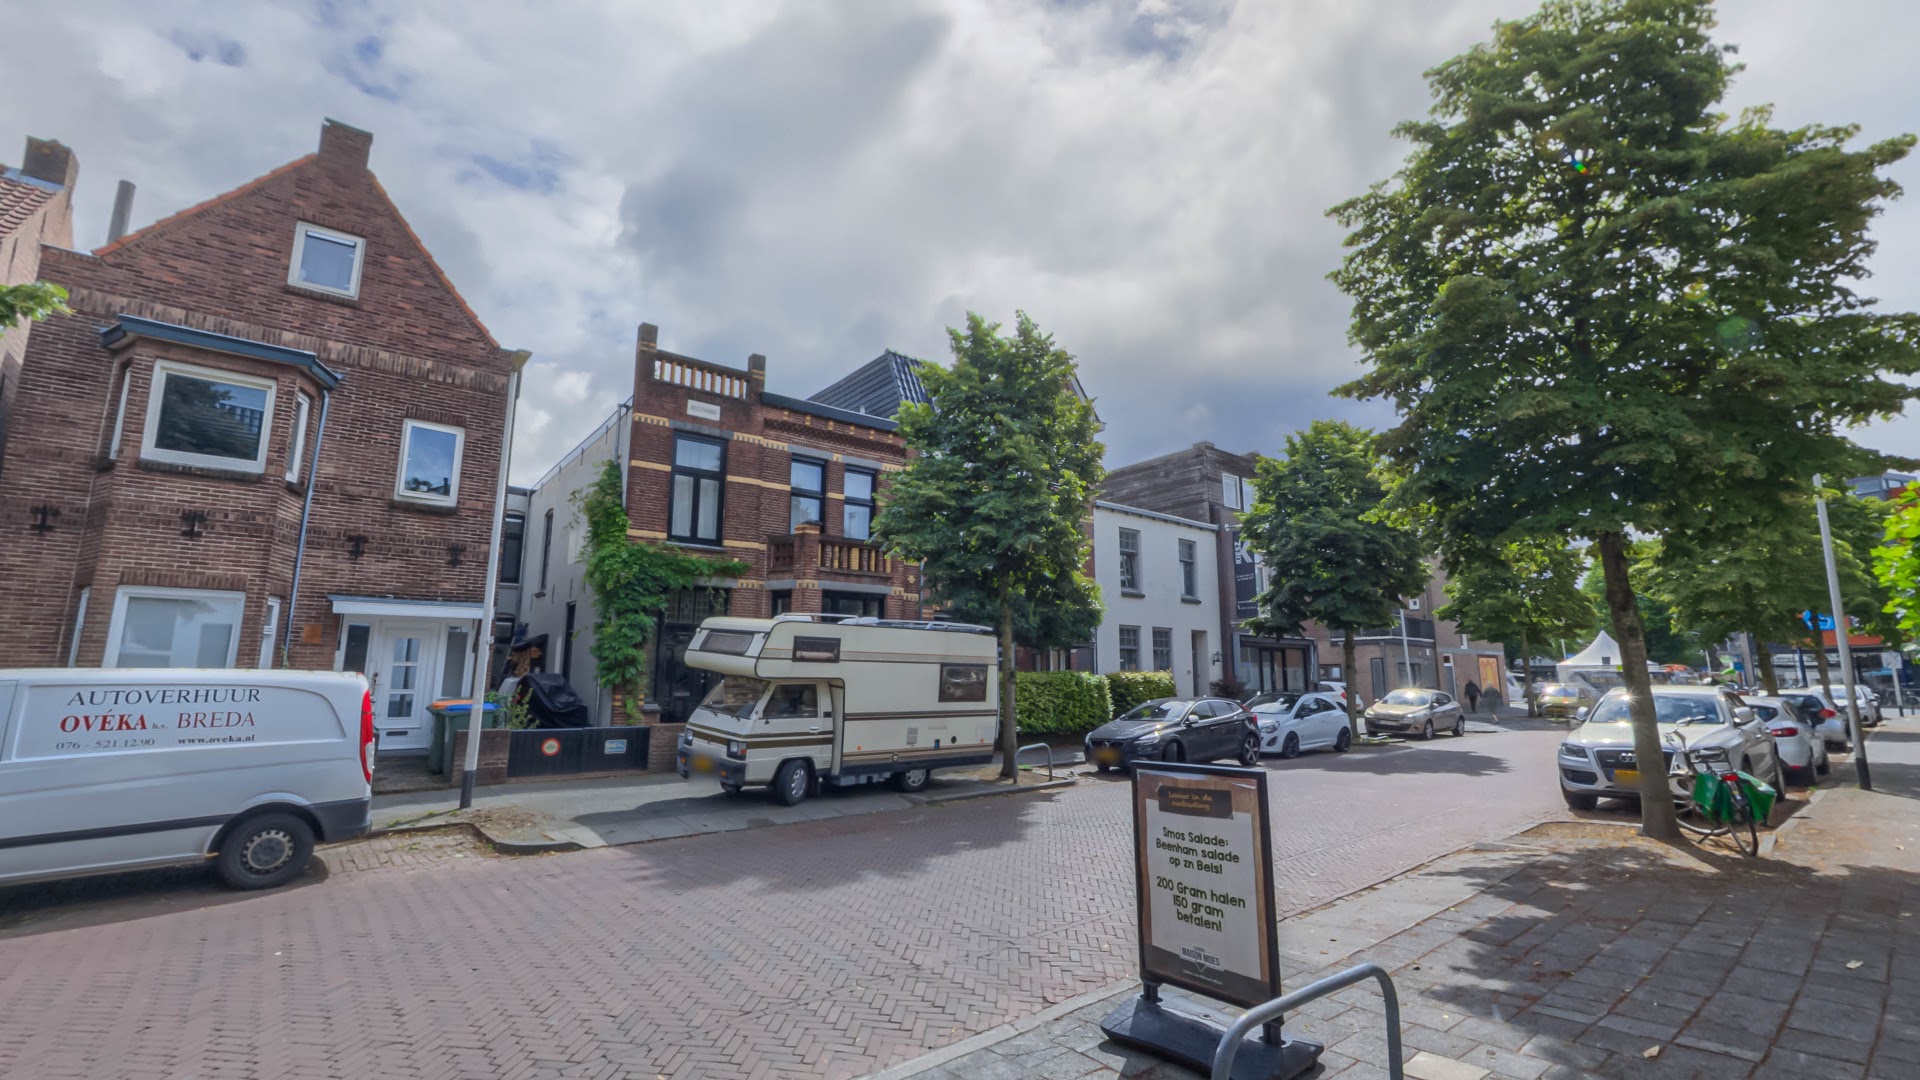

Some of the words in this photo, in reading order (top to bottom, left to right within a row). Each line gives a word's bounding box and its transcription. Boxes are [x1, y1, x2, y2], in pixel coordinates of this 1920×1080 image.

[66, 688, 261, 706] AUTOVERHUUR
[59, 709, 148, 733] OVÉKA
[177, 711, 255, 729] BREDA
[55, 741, 81, 750] 076
[94, 738, 156, 749] 521.12.90
[177, 734, 256, 744] www.oveka.nl
[1162, 826, 1186, 841] Smos
[1188, 831, 1229, 847] Salade:
[1156, 838, 1198, 857] Beenham
[1201, 849, 1240, 863] salade
[1169, 856, 1181, 868] op
[1183, 859, 1194, 869] zn
[1196, 860, 1223, 875] Bels!
[1156, 875, 1174, 891] 200
[1177, 881, 1207, 900] Gram
[1210, 889, 1246, 908] halen
[1173, 893, 1188, 909] 150
[1191, 902, 1224, 919] gram
[1176, 908, 1222, 932] betalen!
